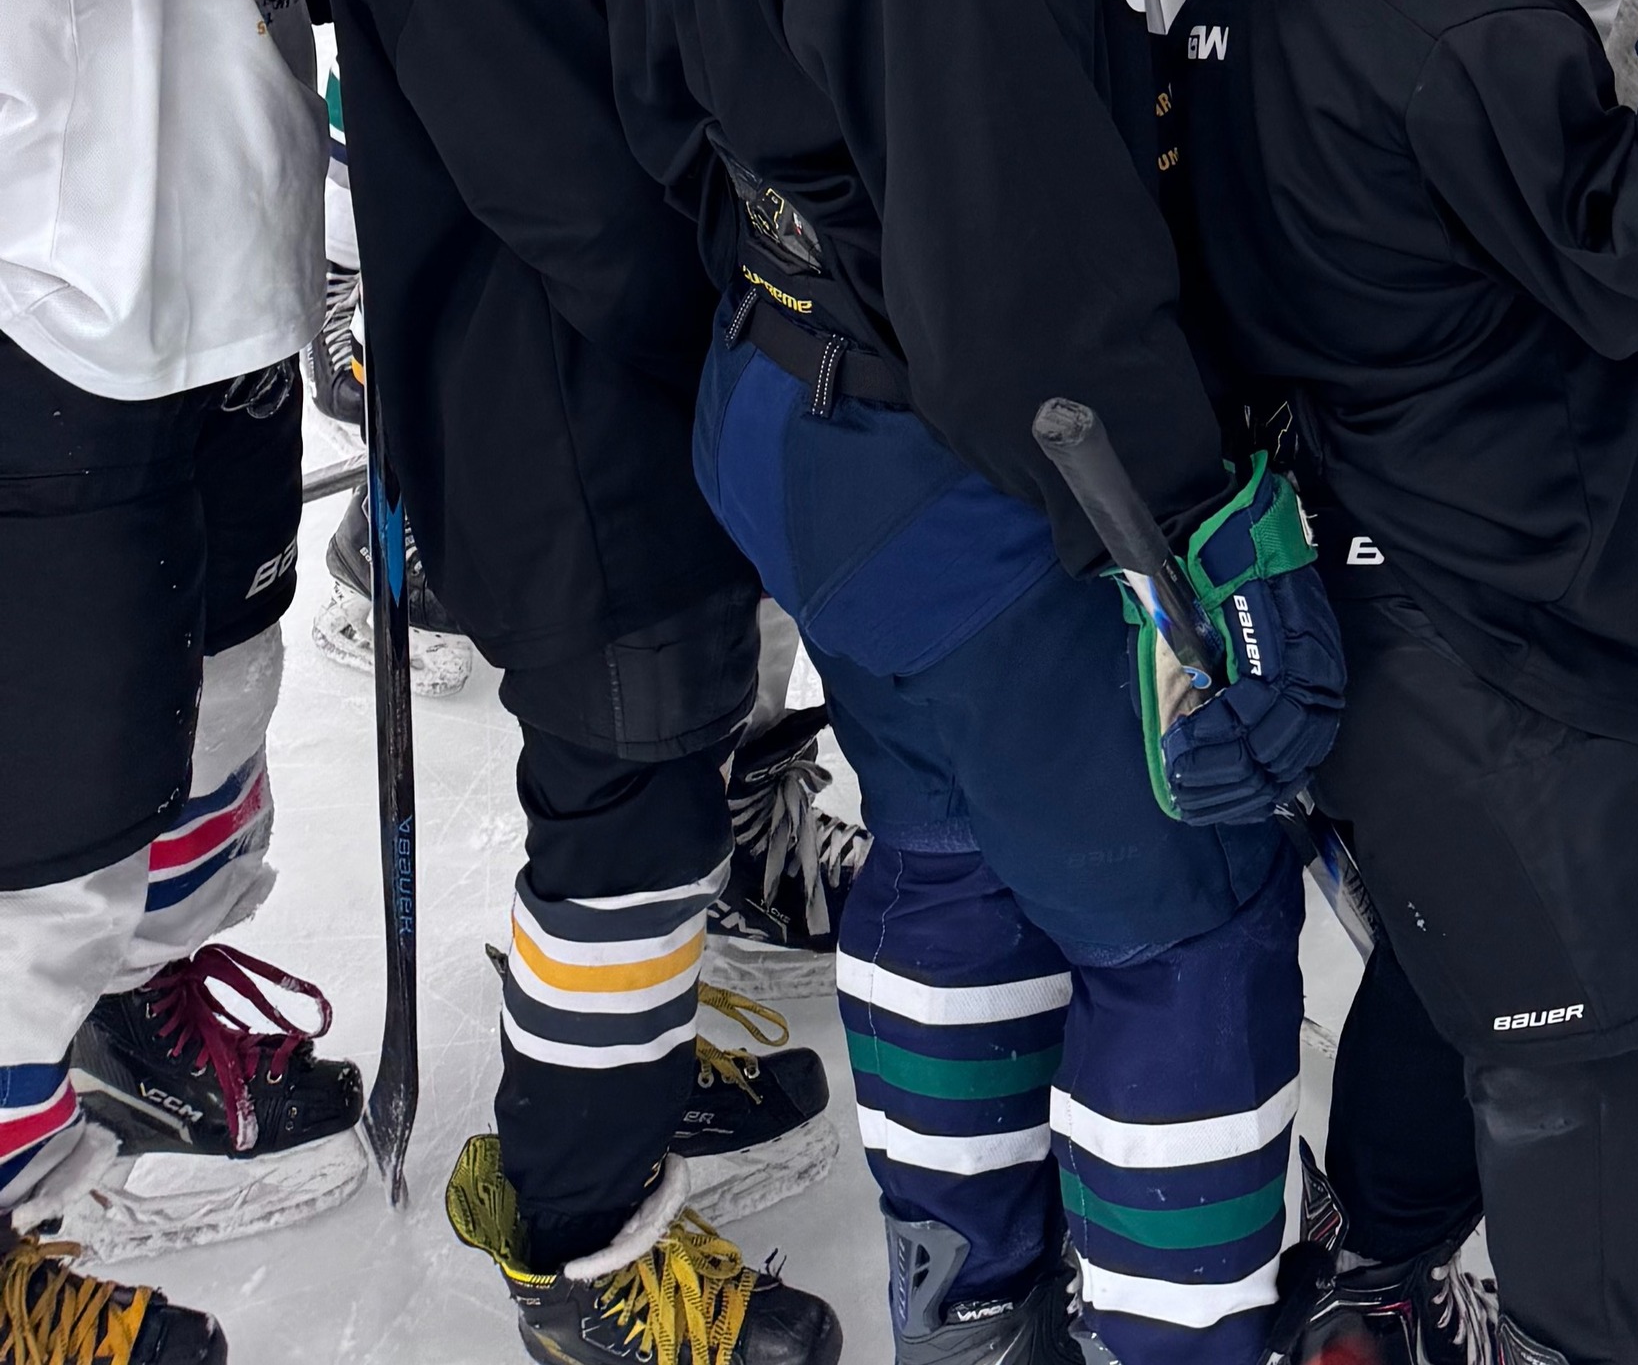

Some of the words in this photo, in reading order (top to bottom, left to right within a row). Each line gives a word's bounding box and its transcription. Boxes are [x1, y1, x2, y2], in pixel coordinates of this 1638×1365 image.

[1233, 594, 1263, 677] BAUER
[398, 838, 414, 935] BAUER
[1493, 1004, 1585, 1031] BAUER
[146, 1087, 204, 1123] CCM
